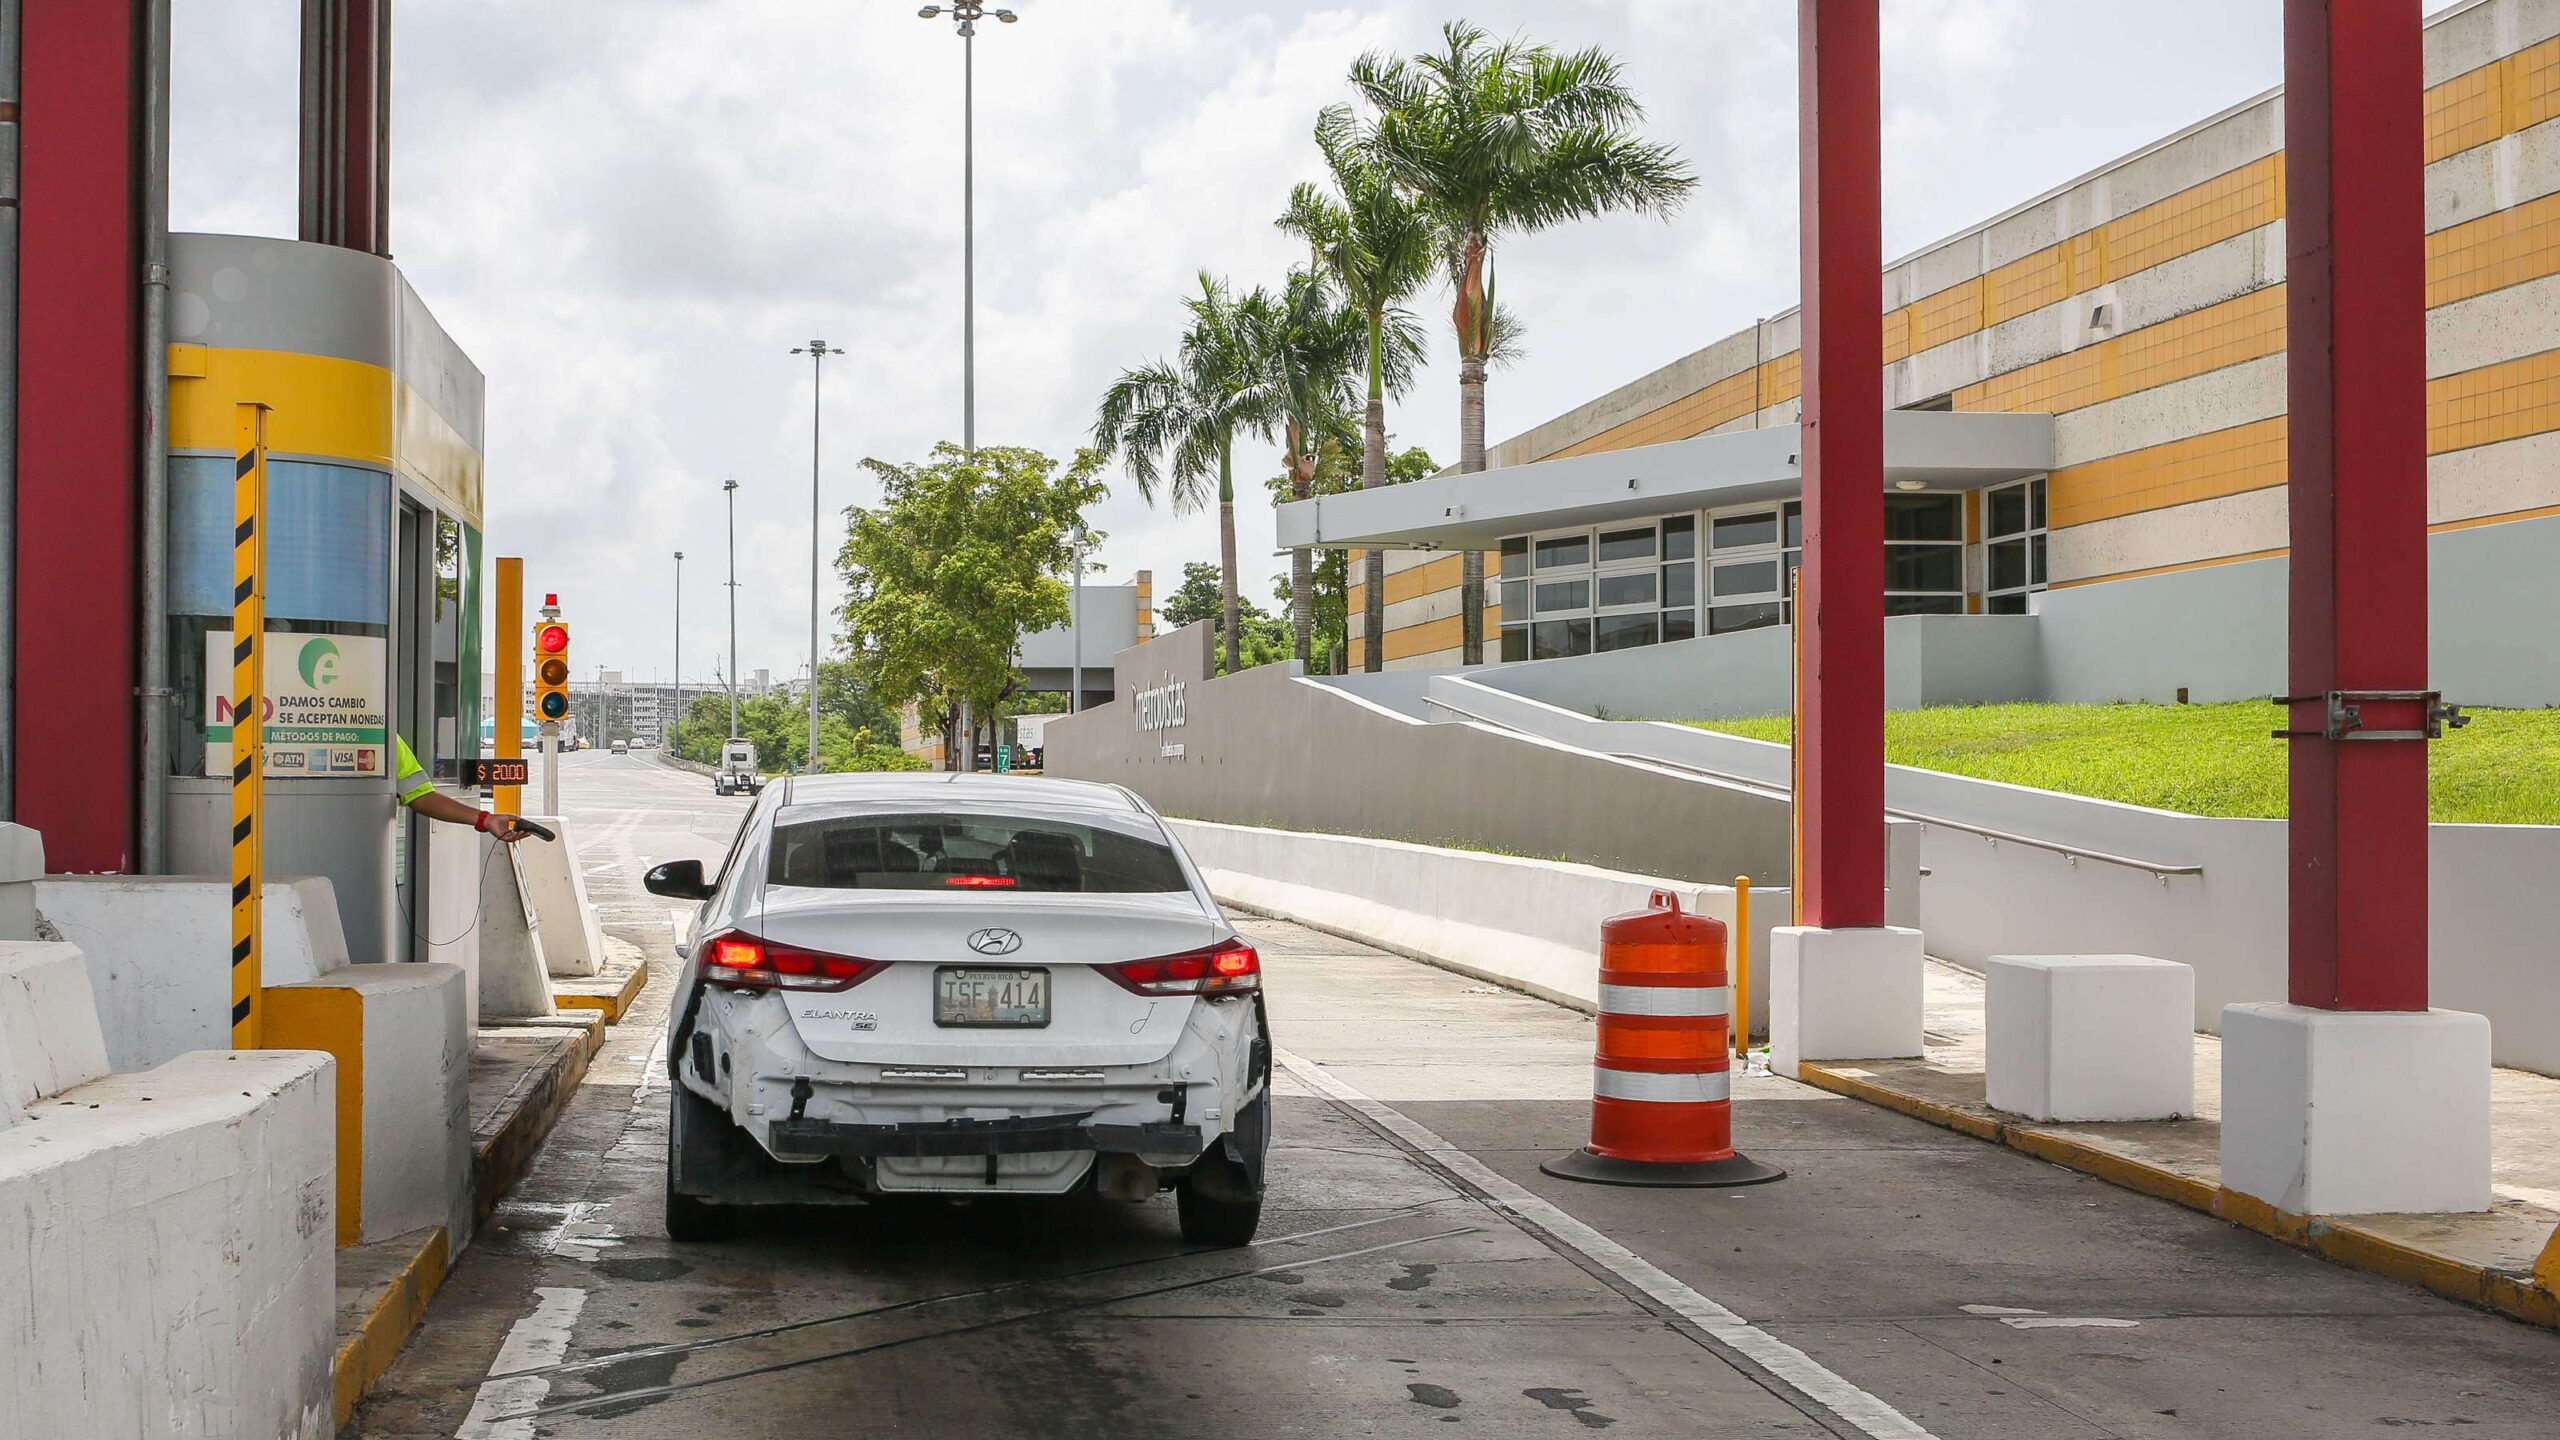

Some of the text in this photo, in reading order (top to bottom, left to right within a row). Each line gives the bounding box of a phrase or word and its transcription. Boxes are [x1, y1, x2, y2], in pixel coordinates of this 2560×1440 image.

[279, 696, 366, 709] DAMOS CAMBIO
[279, 713, 384, 726] SE ACEPTAN MONEDAS
[271, 729, 359, 742] MÉTODOS DE PAGO:
[284, 753, 303, 764] ATH
[334, 752, 354, 763] VISA
[1000, 754, 1008, 766] 7
[478, 764, 486, 781] $
[1000, 982, 1040, 1009] 414
[801, 1009, 878, 1021] ELANTRA
